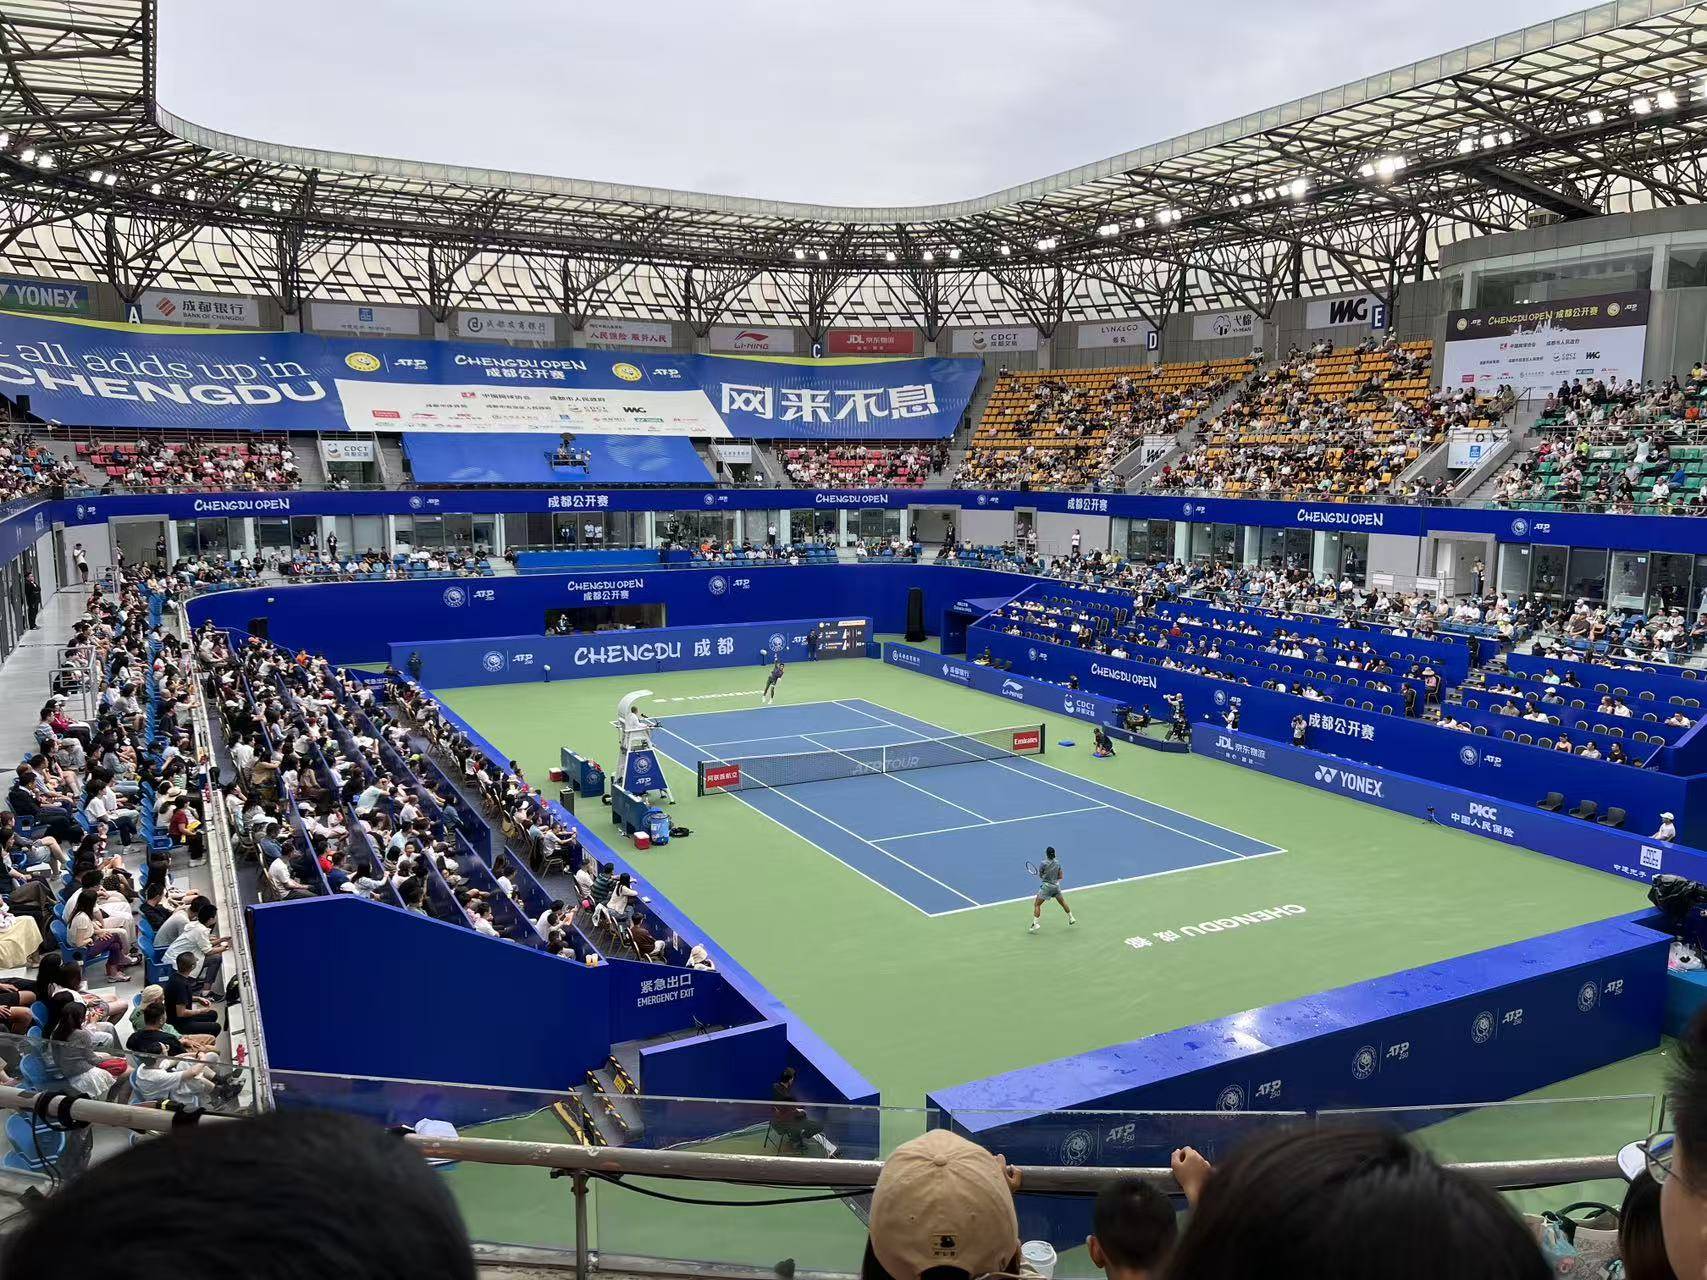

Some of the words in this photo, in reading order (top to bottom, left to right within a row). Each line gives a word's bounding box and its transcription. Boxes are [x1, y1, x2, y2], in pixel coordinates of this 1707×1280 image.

[15, 285, 78, 309] YONEX
[129, 306, 141, 324] A
[183, 300, 244, 315] 成都银行
[1375, 307, 1382, 326] E
[1488, 313, 1528, 325] CHENGDU
[1529, 311, 1552, 322] OPEN
[847, 335, 864, 344] JDL
[1149, 333, 1157, 349] D
[813, 344, 821, 359] C
[16, 342, 78, 369] all
[83, 353, 193, 379] adds
[196, 362, 258, 384] up
[259, 357, 310, 378] in
[454, 354, 538, 368] CHENGDU
[543, 359, 587, 370] OPEN
[486, 368, 566, 380] 成都公开赛
[0, 362, 327, 405] CHENGDU
[721, 383, 939, 423] 网来不息
[194, 499, 253, 513] CHENGDU
[255, 498, 290, 510] OPEN
[548, 495, 609, 508] 成都公开赛
[816, 494, 861, 504] CHENGDU
[864, 493, 888, 503] OPEN
[1067, 498, 1108, 512] 成都公开赛
[1297, 509, 1349, 524] CHENGDU
[1351, 511, 1383, 527] OPEN
[568, 581, 615, 591] CHENGDU
[617, 579, 643, 588] OPEN
[584, 590, 630, 601] 成都公开赛
[574, 641, 681, 666] CHENGDU
[693, 636, 735, 658] 成都
[1091, 663, 1132, 684] CHENGDU
[1132, 674, 1157, 689] OPEN
[1076, 700, 1095, 710] CDCT
[1309, 712, 1375, 741] 成都公开赛
[1014, 736, 1038, 745] Emirates
[1216, 736, 1234, 750] JDL
[1340, 769, 1382, 797] YONEX
[1469, 802, 1497, 820] PICC
[1451, 812, 1514, 837] 中国人民保险
[1180, 904, 1306, 937] CHENGDU
[640, 973, 691, 994] 紧急出口
[637, 990, 678, 1007] EMERGENCY
[680, 988, 695, 999] EXIT
[1502, 1009, 1523, 1024] ATP
[1386, 1041, 1409, 1057] ATP
[1255, 1080, 1282, 1098] ATP
[1106, 1123, 1135, 1142] ATP
